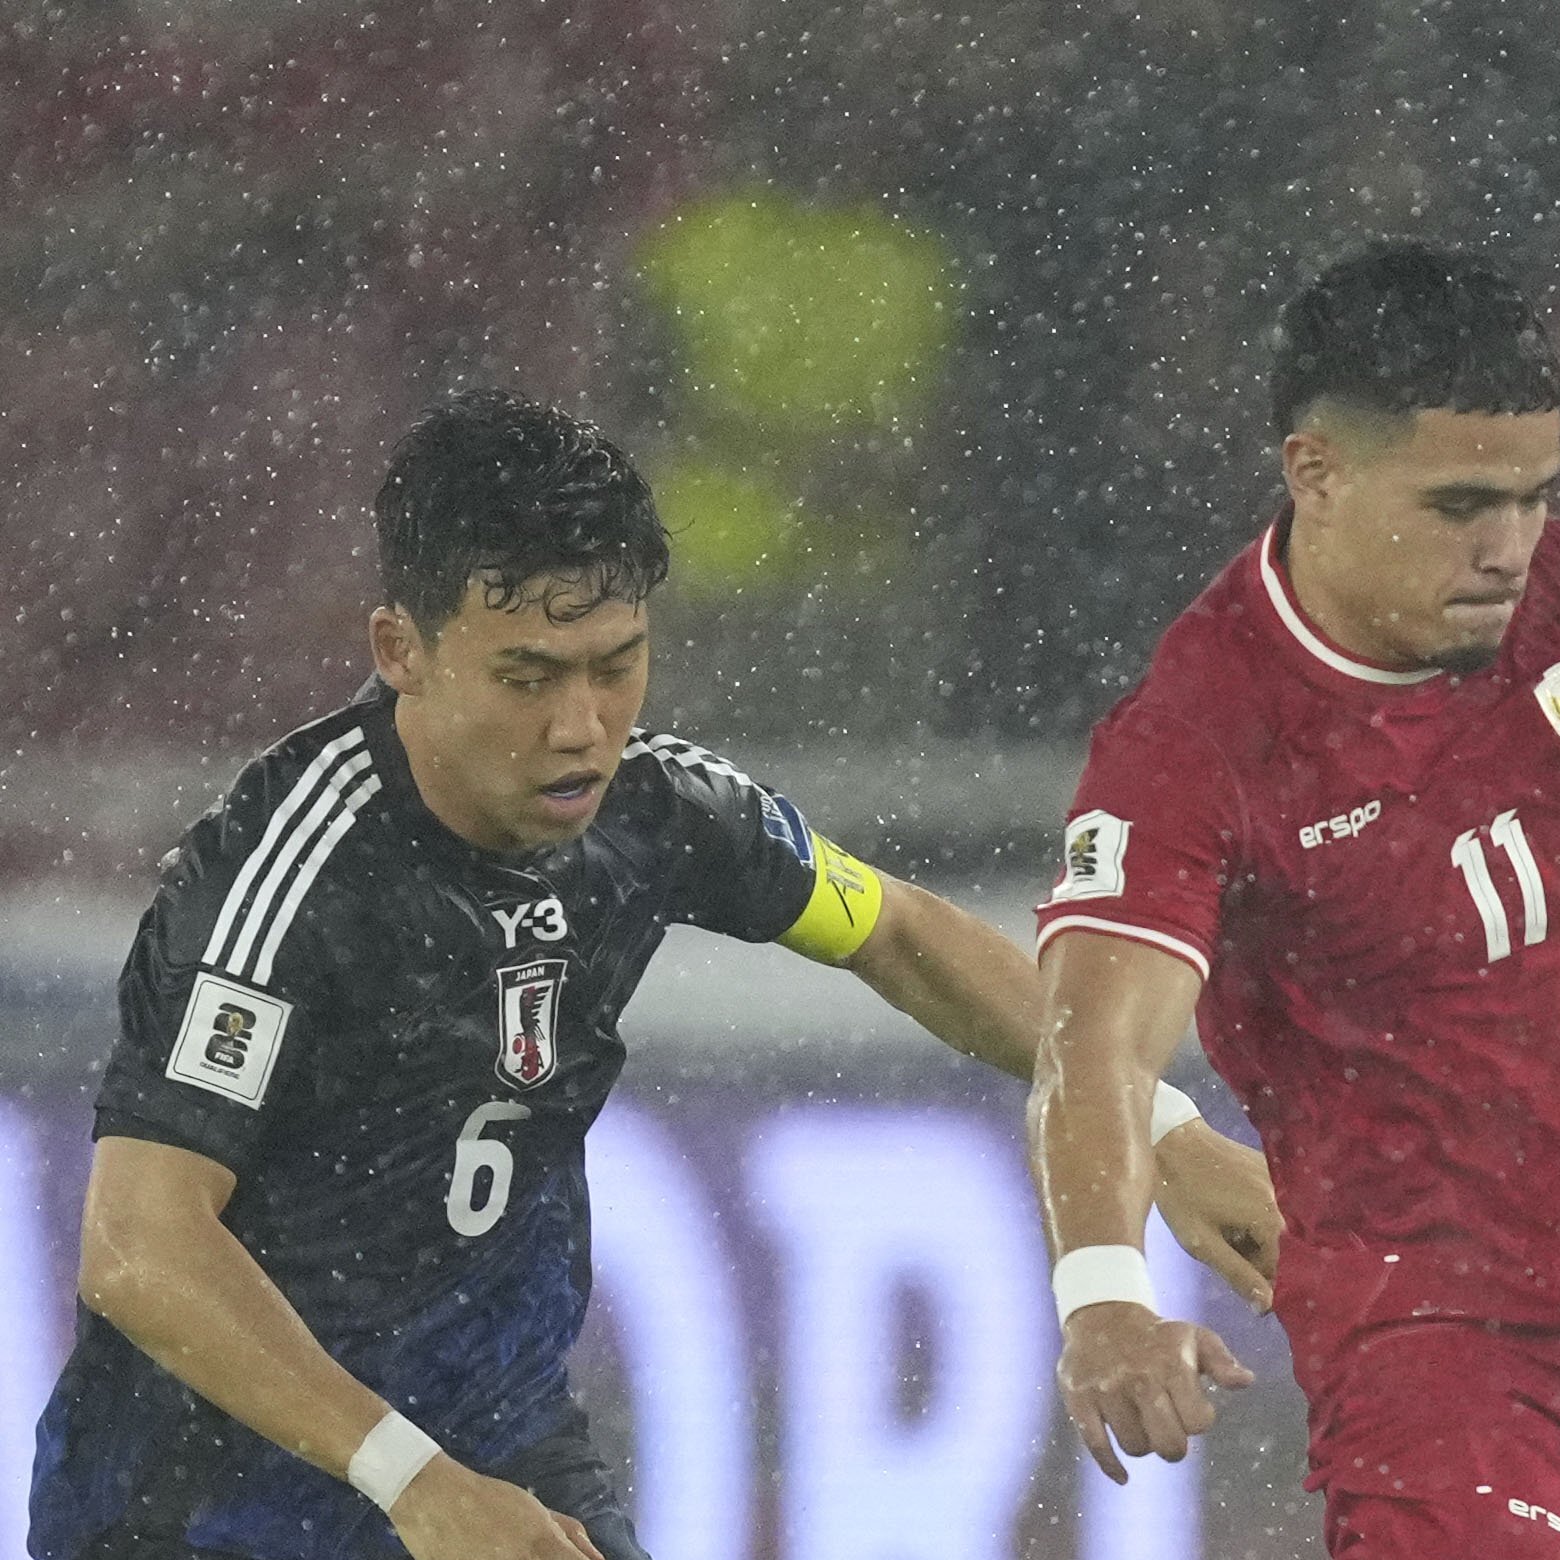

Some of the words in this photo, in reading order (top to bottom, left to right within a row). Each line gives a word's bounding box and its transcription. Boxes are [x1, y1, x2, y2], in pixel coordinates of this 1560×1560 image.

[1299, 800, 1381, 849] erspo
[1450, 808, 1548, 964] 11
[491, 898, 568, 949] Y-3
[515, 966, 545, 981] JAPAN
[446, 1101, 532, 1237] 6
